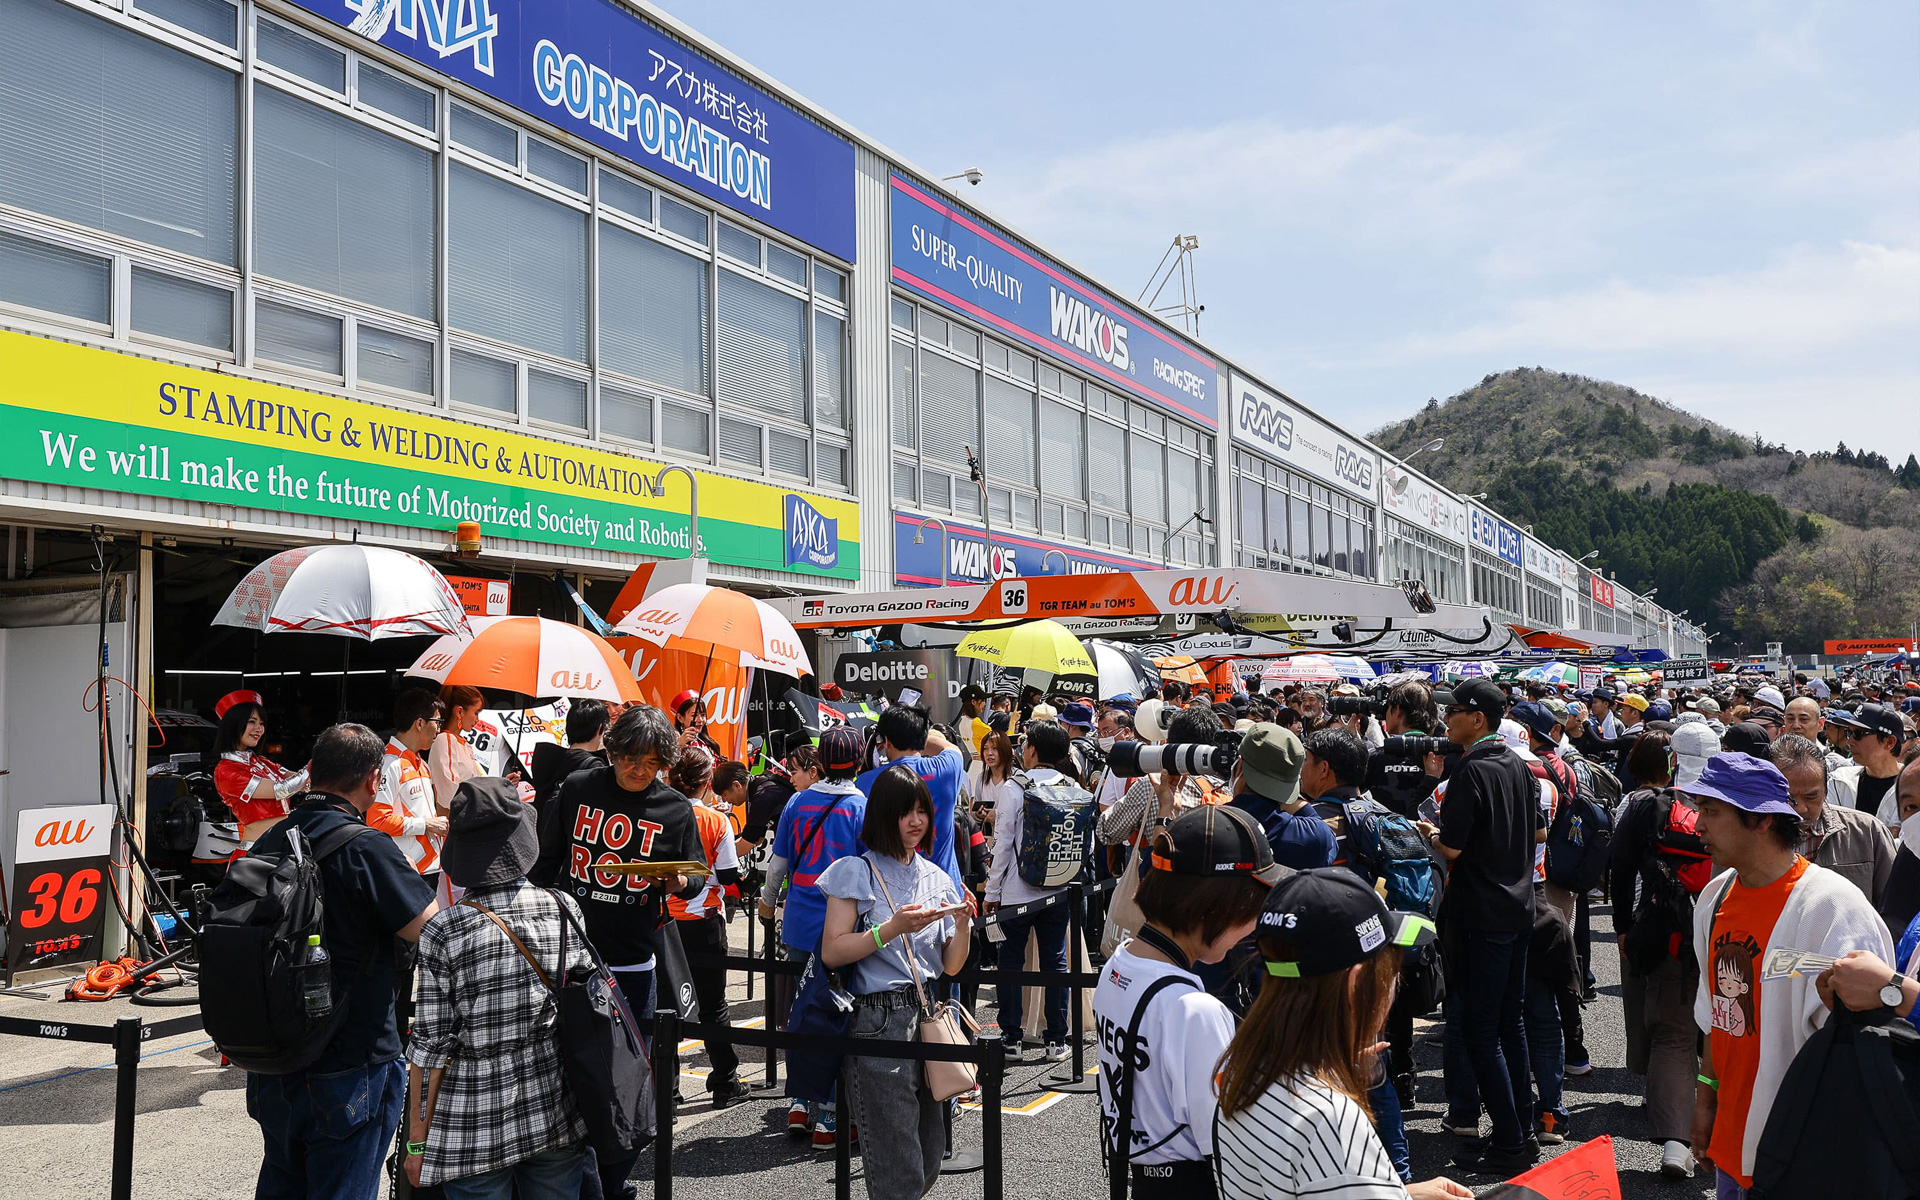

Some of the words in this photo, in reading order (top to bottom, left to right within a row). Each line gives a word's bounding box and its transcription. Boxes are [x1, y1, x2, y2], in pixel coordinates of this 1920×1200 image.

[648, 48, 770, 145] アスカ株式会社
[533, 39, 771, 211] CORPORATION
[911, 223, 1024, 304] SUPER-QUALITY
[1050, 285, 1130, 371] WAKO'S
[1153, 357, 1184, 386] RACING
[1182, 370, 1206, 401] SPEC
[1240, 391, 1294, 452] RAYS
[159, 382, 332, 443] STAMPING
[340, 417, 362, 449] &
[368, 422, 489, 471] WELDING
[495, 446, 513, 474] &
[518, 451, 656, 499] AUTOMATION
[1335, 443, 1373, 491] RAYS
[39, 429, 97, 473] We
[106, 443, 171, 482] will
[180, 456, 259, 494] make
[266, 464, 309, 501] the
[316, 470, 391, 511] future
[398, 484, 422, 515] of
[426, 487, 532, 530] Motorized
[537, 504, 601, 546] Society
[604, 518, 637, 543] and
[792, 500, 829, 560] ASKA
[1472, 509, 1496, 550] EXEDY
[808, 549, 836, 565] CORPORATION
[950, 538, 1017, 580] WAKO'S
[461, 581, 482, 591] TOM'S
[1169, 576, 1236, 606] au
[488, 593, 507, 604] au
[802, 605, 824, 617] GR
[827, 605, 875, 615] TOYOTA
[878, 602, 923, 612] GAZOO
[925, 599, 969, 611] Racing
[1003, 589, 1025, 607] 36
[1040, 601, 1059, 611] TGR
[1061, 600, 1088, 610] TEAM
[1104, 598, 1136, 608] TOM'S
[636, 608, 682, 626] au
[1084, 621, 1118, 629] GAZOO
[1177, 613, 1192, 625] 37
[1256, 615, 1277, 623] TOM'S
[770, 639, 799, 660] au
[1193, 641, 1232, 649] LEXUS
[1847, 642, 1906, 650] AUTOBACS
[420, 653, 454, 671] au
[551, 670, 602, 691] au
[1665, 668, 1704, 679] 受付終了
[1056, 680, 1094, 694] TOM'S
[464, 728, 490, 751] 36
[507, 725, 546, 735] GROUP
[35, 819, 95, 848] au
[573, 804, 664, 857] HOT
[1061, 807, 1076, 861] NORTH
[1048, 823, 1064, 861] FACE
[1070, 831, 1084, 861] THE
[570, 843, 651, 892] ROD
[20, 869, 101, 929] 36
[1355, 919, 1374, 937] SUPER
[35, 934, 81, 955] TOM'S
[40, 1024, 68, 1037] TOM'S
[1144, 1166, 1173, 1178] DENSO
